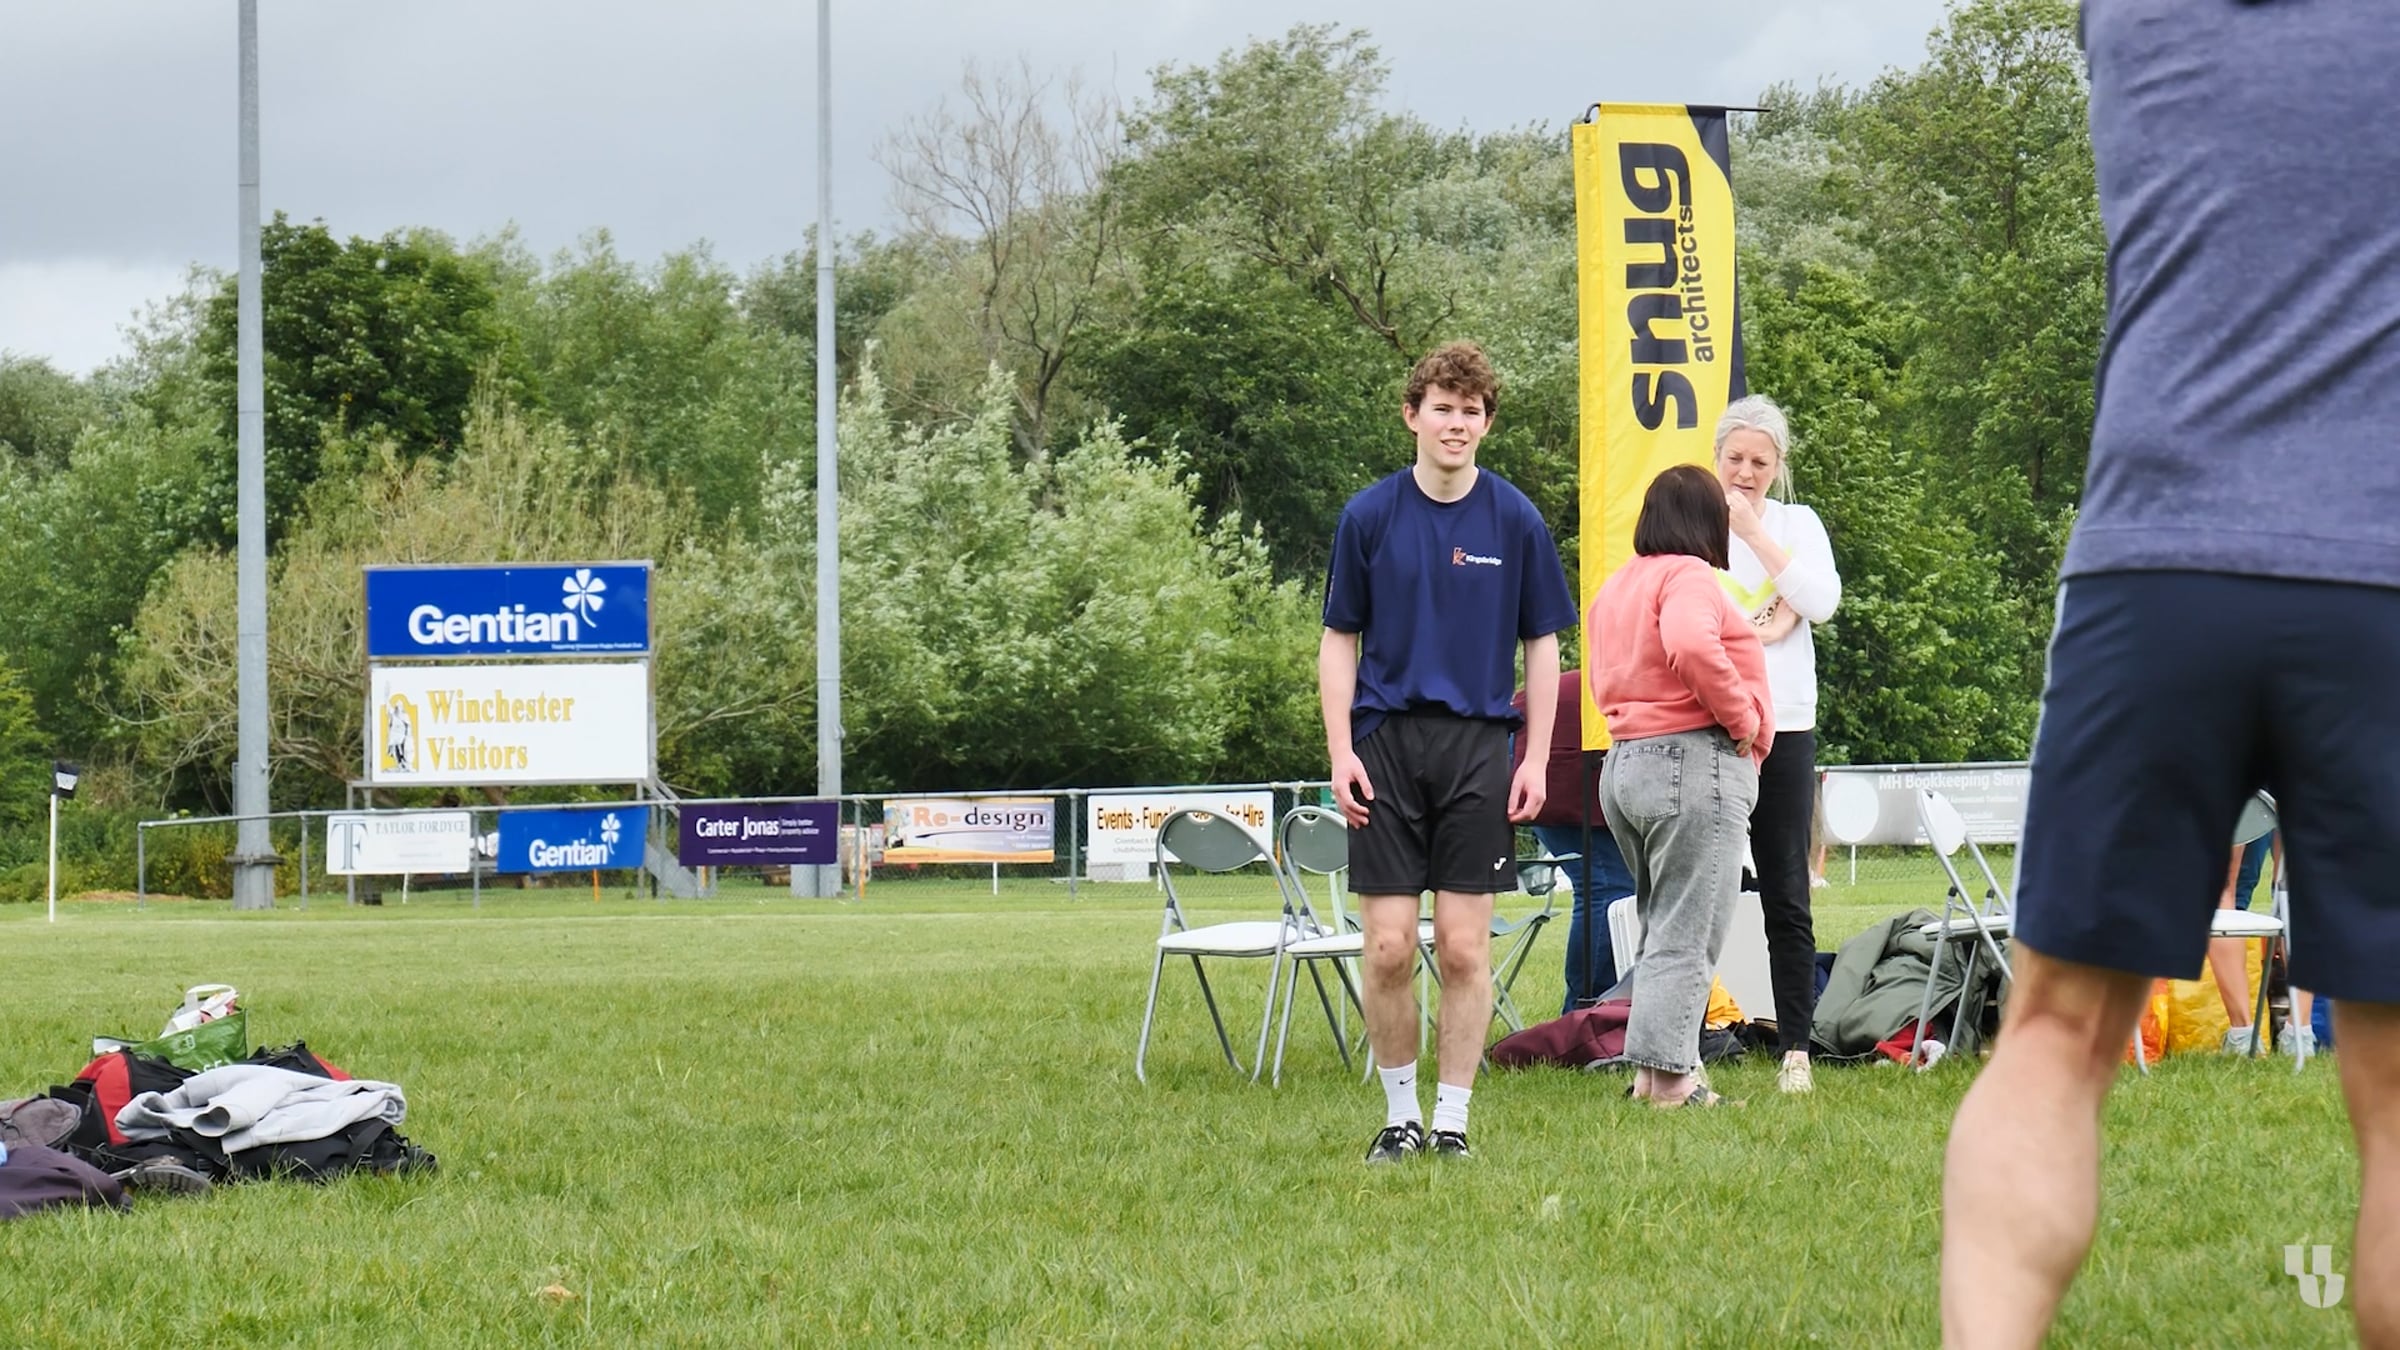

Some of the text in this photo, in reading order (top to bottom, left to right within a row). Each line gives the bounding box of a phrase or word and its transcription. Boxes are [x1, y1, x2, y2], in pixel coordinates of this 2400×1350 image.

[1618, 141, 1698, 431] snug
[1677, 204, 1715, 363] architects
[408, 604, 577, 645] Gentian
[426, 689, 575, 724] Winchester
[426, 736, 529, 771] Visitors
[1879, 771, 2026, 791] MH Bookkeeping Servi
[375, 820, 467, 835] TAYLOR FORDYCE
[696, 815, 780, 840] Carter Jonas
[1097, 807, 1133, 829] Events
[1243, 803, 1265, 827] Hire
[528, 837, 608, 868] Gentian
